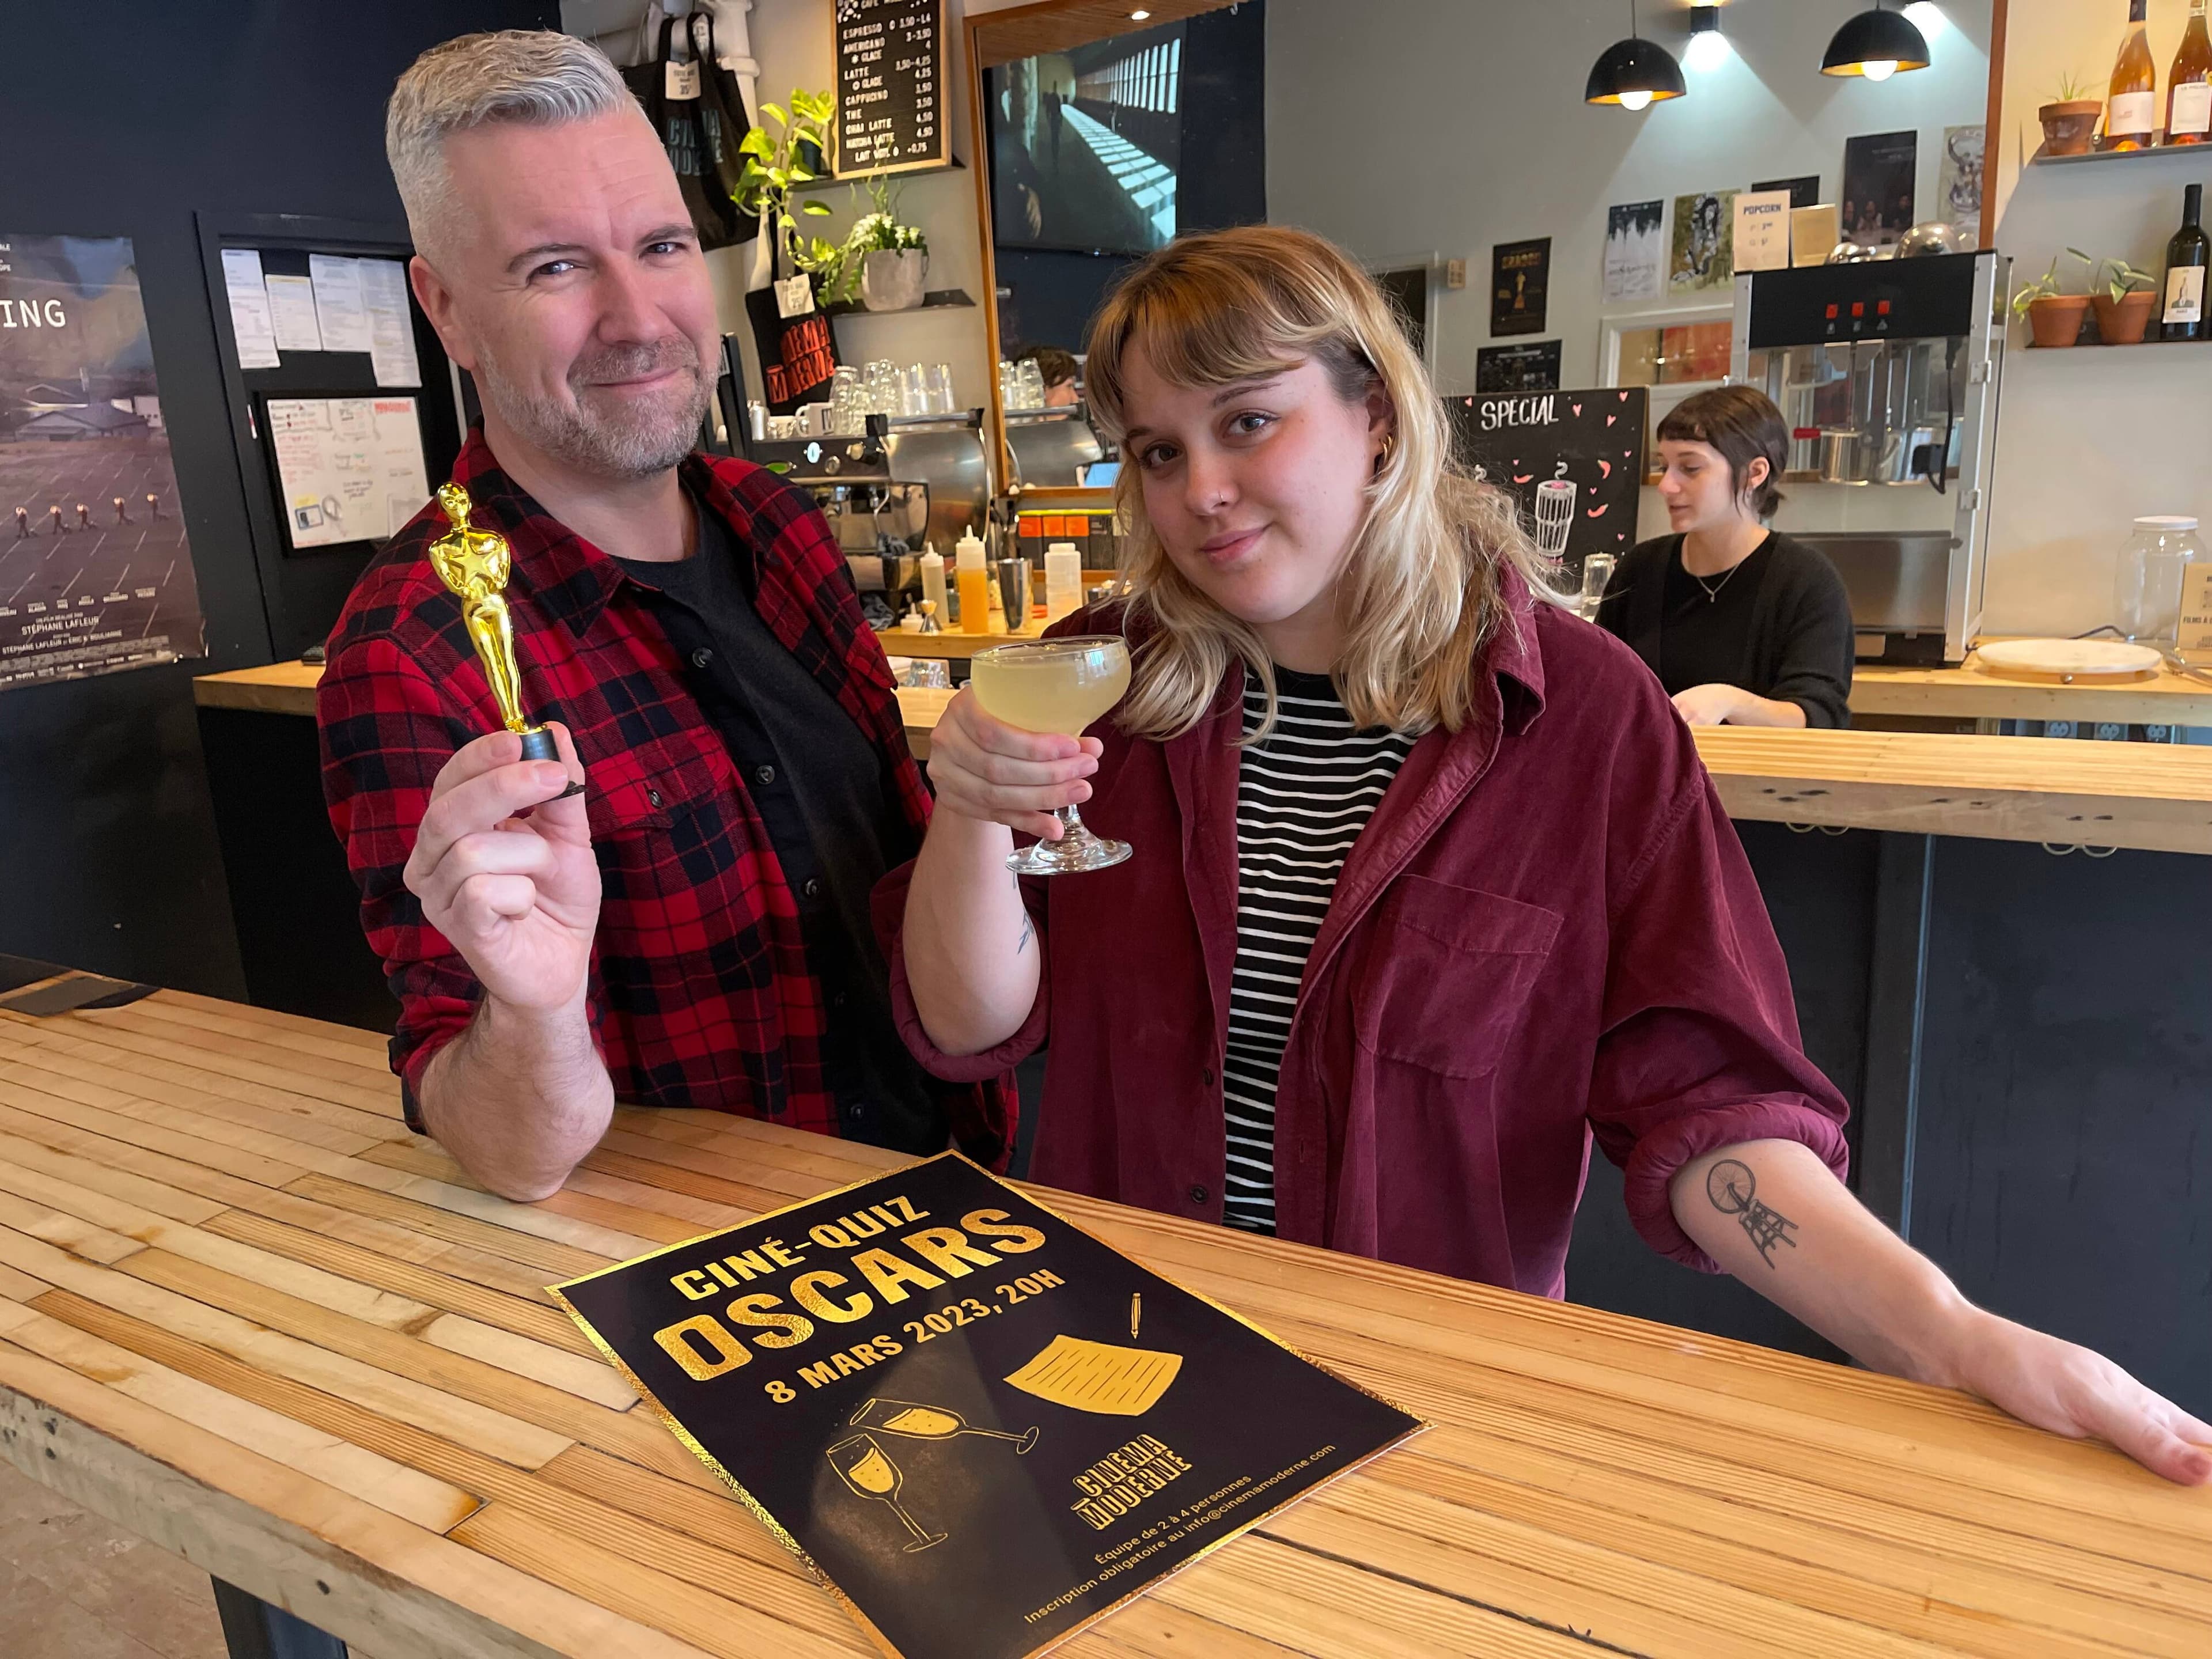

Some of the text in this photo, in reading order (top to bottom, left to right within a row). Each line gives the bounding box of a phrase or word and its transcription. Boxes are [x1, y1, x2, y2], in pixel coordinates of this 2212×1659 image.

[843, 22, 882, 40] ESPRESSO
[843, 37, 885, 54] AMERICANO
[844, 66, 869, 80] LATTE
[869, 118, 892, 131] LATTE
[874, 132, 895, 144] LATTE
[1743, 203, 1781, 215] POPCORN
[0, 300, 66, 328] ING
[65, 616, 99, 629] LAFLEUR
[36, 638, 62, 649] LAFLEUR
[670, 1195, 931, 1300] CINÉ-QUIZ
[653, 1209, 1046, 1381] OSCARS
[765, 1269, 1066, 1404] 8 MARS 2023, 20H
[1073, 1434, 1168, 1497] CINEMA
[1070, 1450, 1192, 1530] MODERNE
[1094, 1476, 1252, 1565] Équipe de 2 à 4 personnes
[1024, 1444, 1336, 1624] Inscription obligatoire au info@cinemamoderne.com
